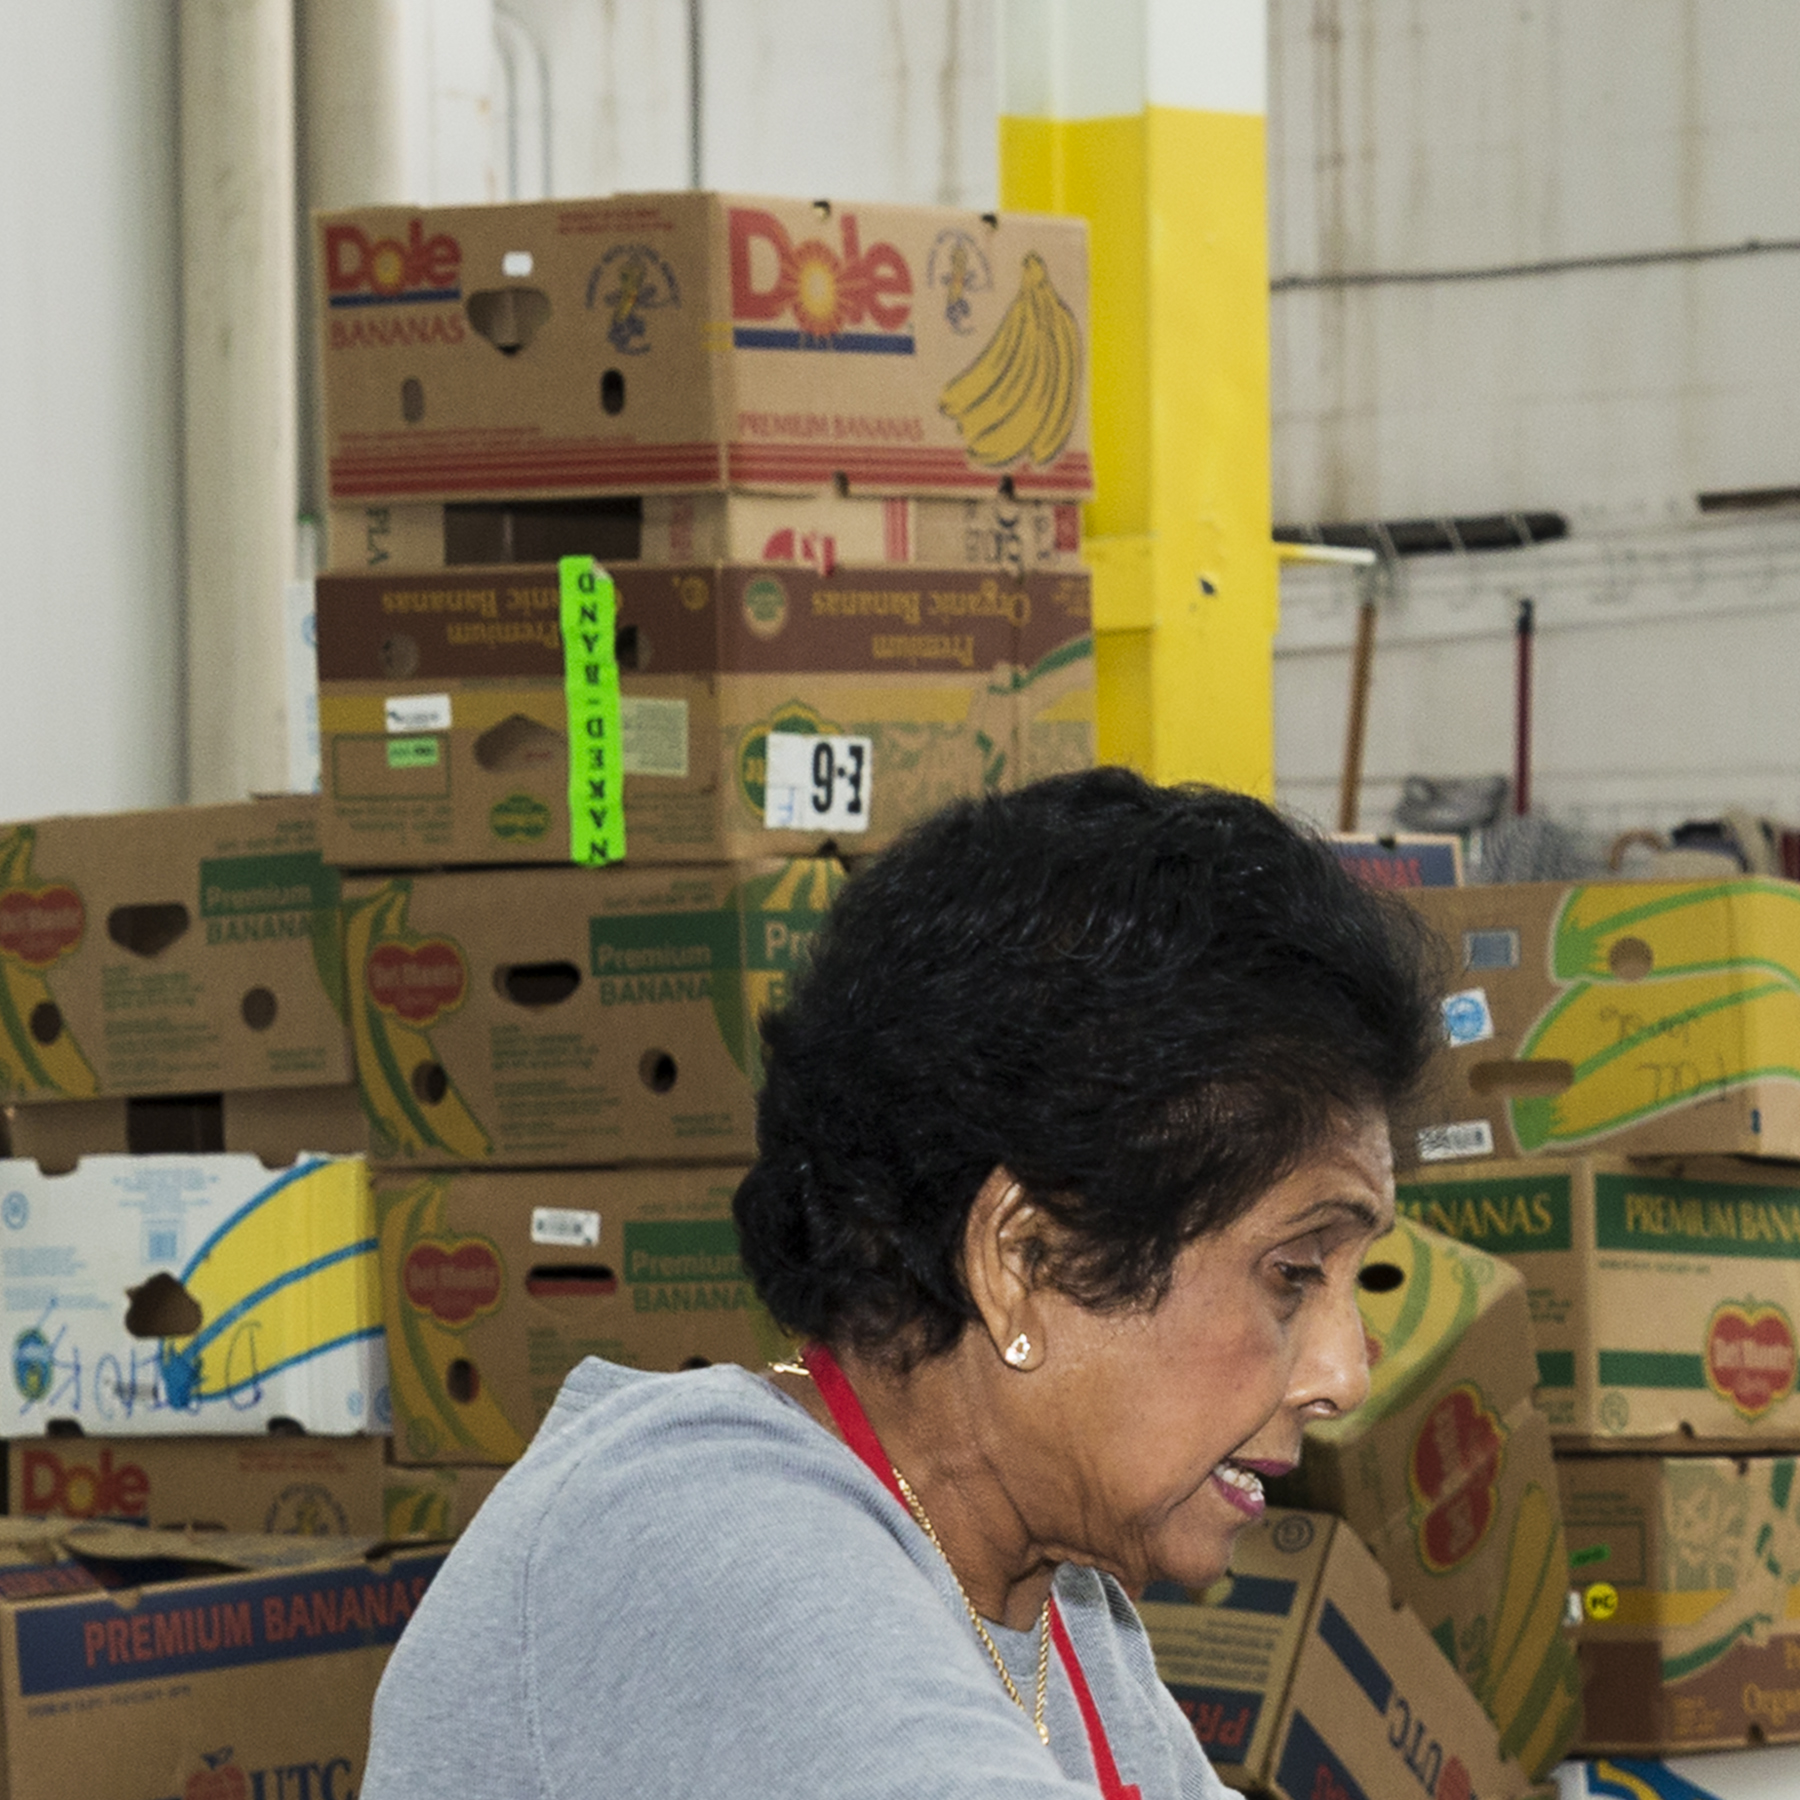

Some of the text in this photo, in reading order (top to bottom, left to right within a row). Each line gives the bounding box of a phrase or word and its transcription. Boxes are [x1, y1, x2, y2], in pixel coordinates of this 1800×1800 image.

[325, 217, 462, 294] Dole
[729, 207, 914, 335] Dole
[22, 1449, 149, 1520] Dole
[82, 1600, 255, 1670] PREMIUM
